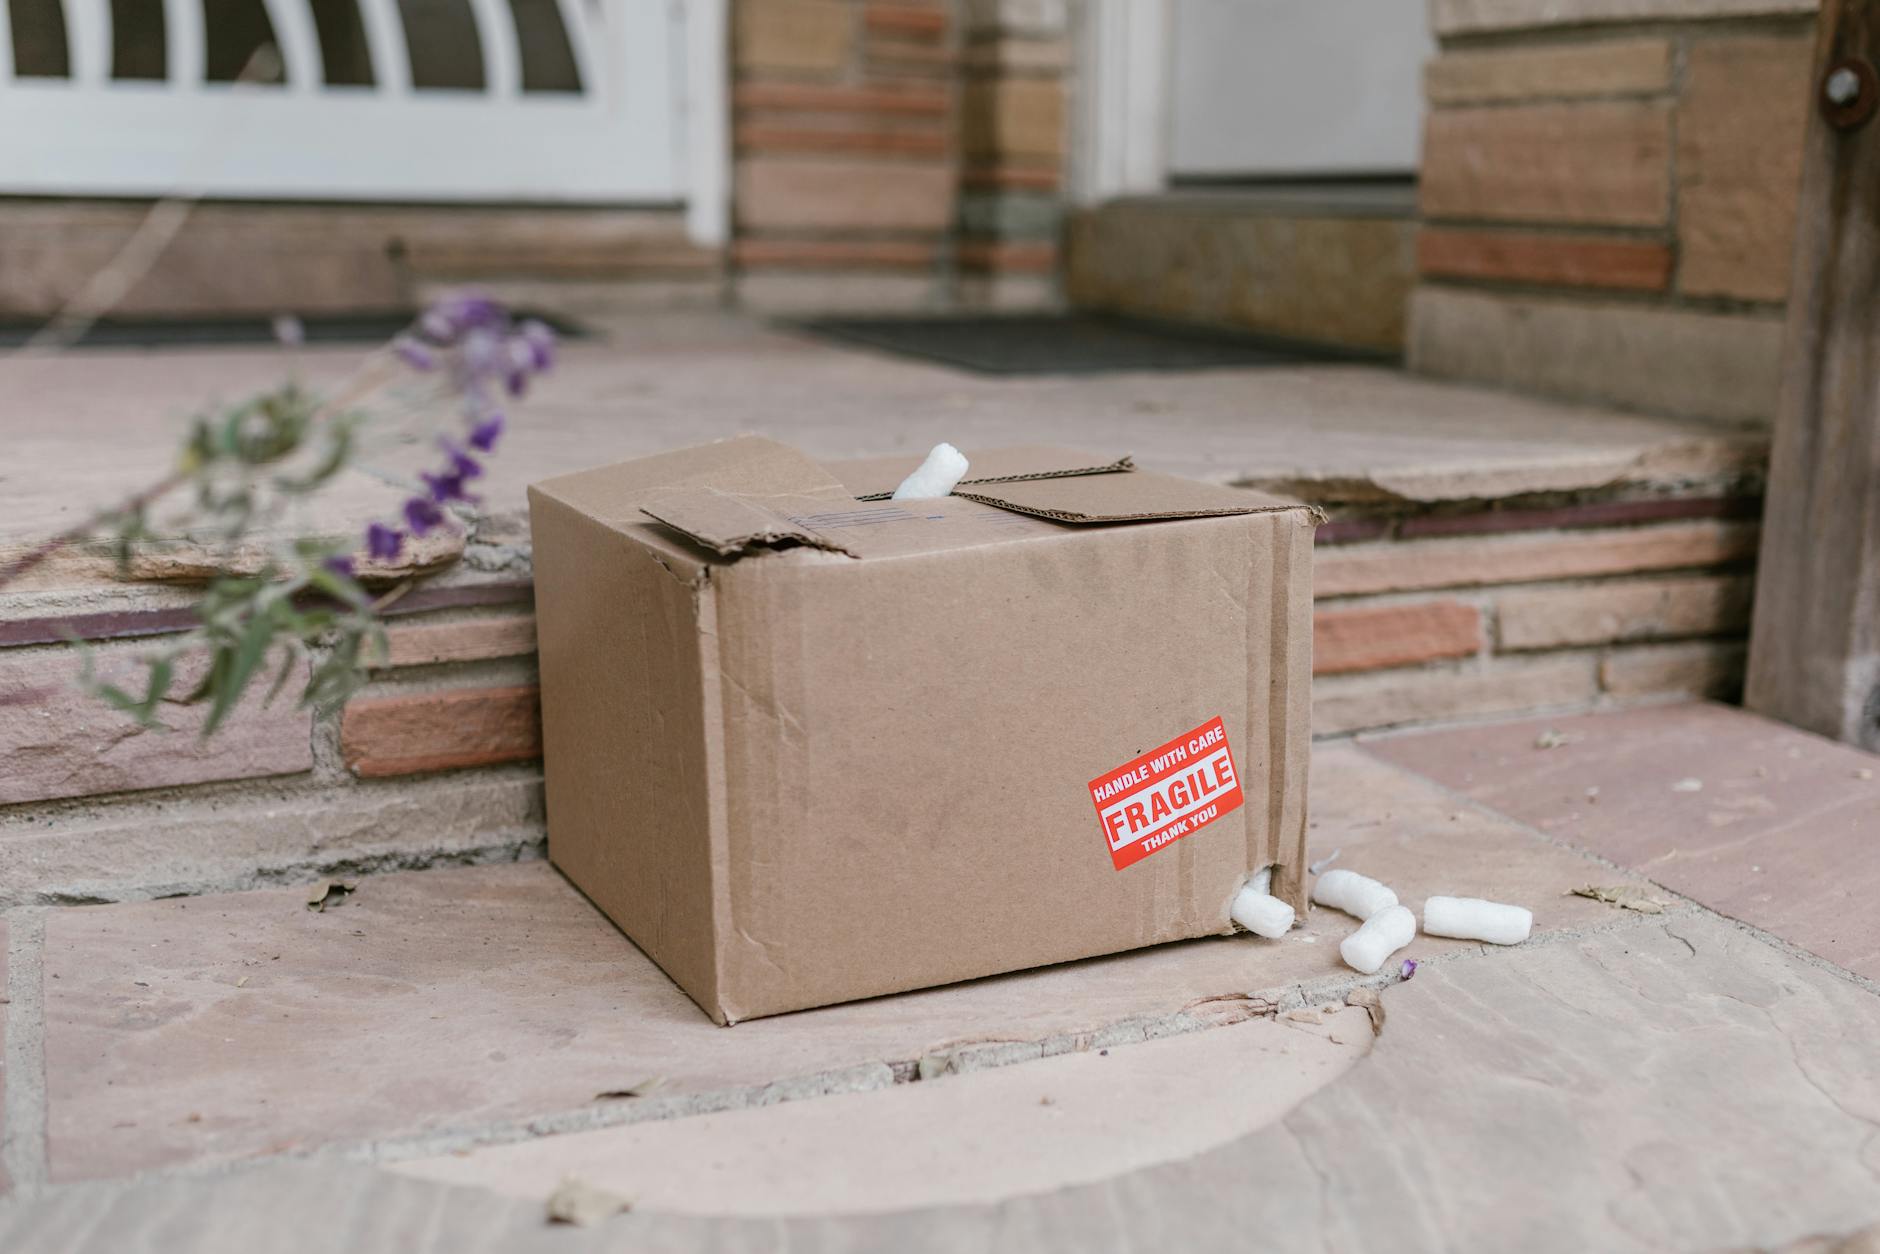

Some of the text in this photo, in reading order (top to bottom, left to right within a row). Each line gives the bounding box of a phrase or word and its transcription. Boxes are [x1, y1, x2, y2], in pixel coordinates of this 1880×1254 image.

[1094, 726, 1224, 802] HANDLE WITH CARE
[1106, 756, 1232, 843] FRAGILE
[1141, 805, 1217, 852] THANK YOU
